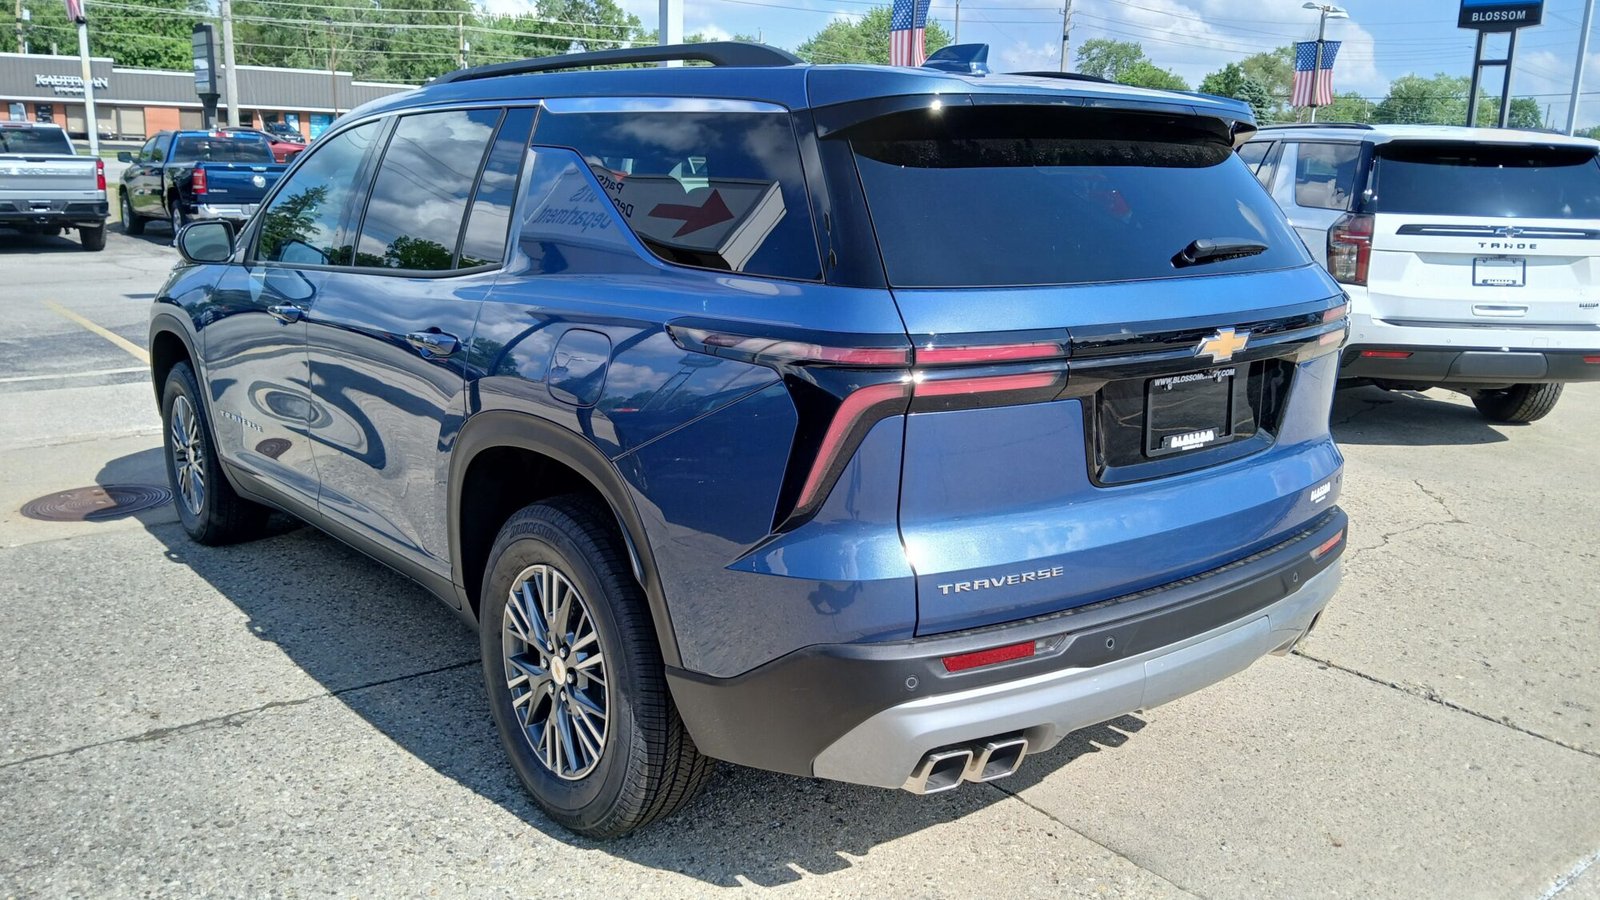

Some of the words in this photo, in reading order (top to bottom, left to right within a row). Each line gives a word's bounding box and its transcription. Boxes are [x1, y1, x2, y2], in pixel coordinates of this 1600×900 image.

[1472, 10, 1526, 22] BLOSSOM
[1478, 241, 1538, 250] TAHOE
[937, 566, 1065, 595] TRAVERSE
